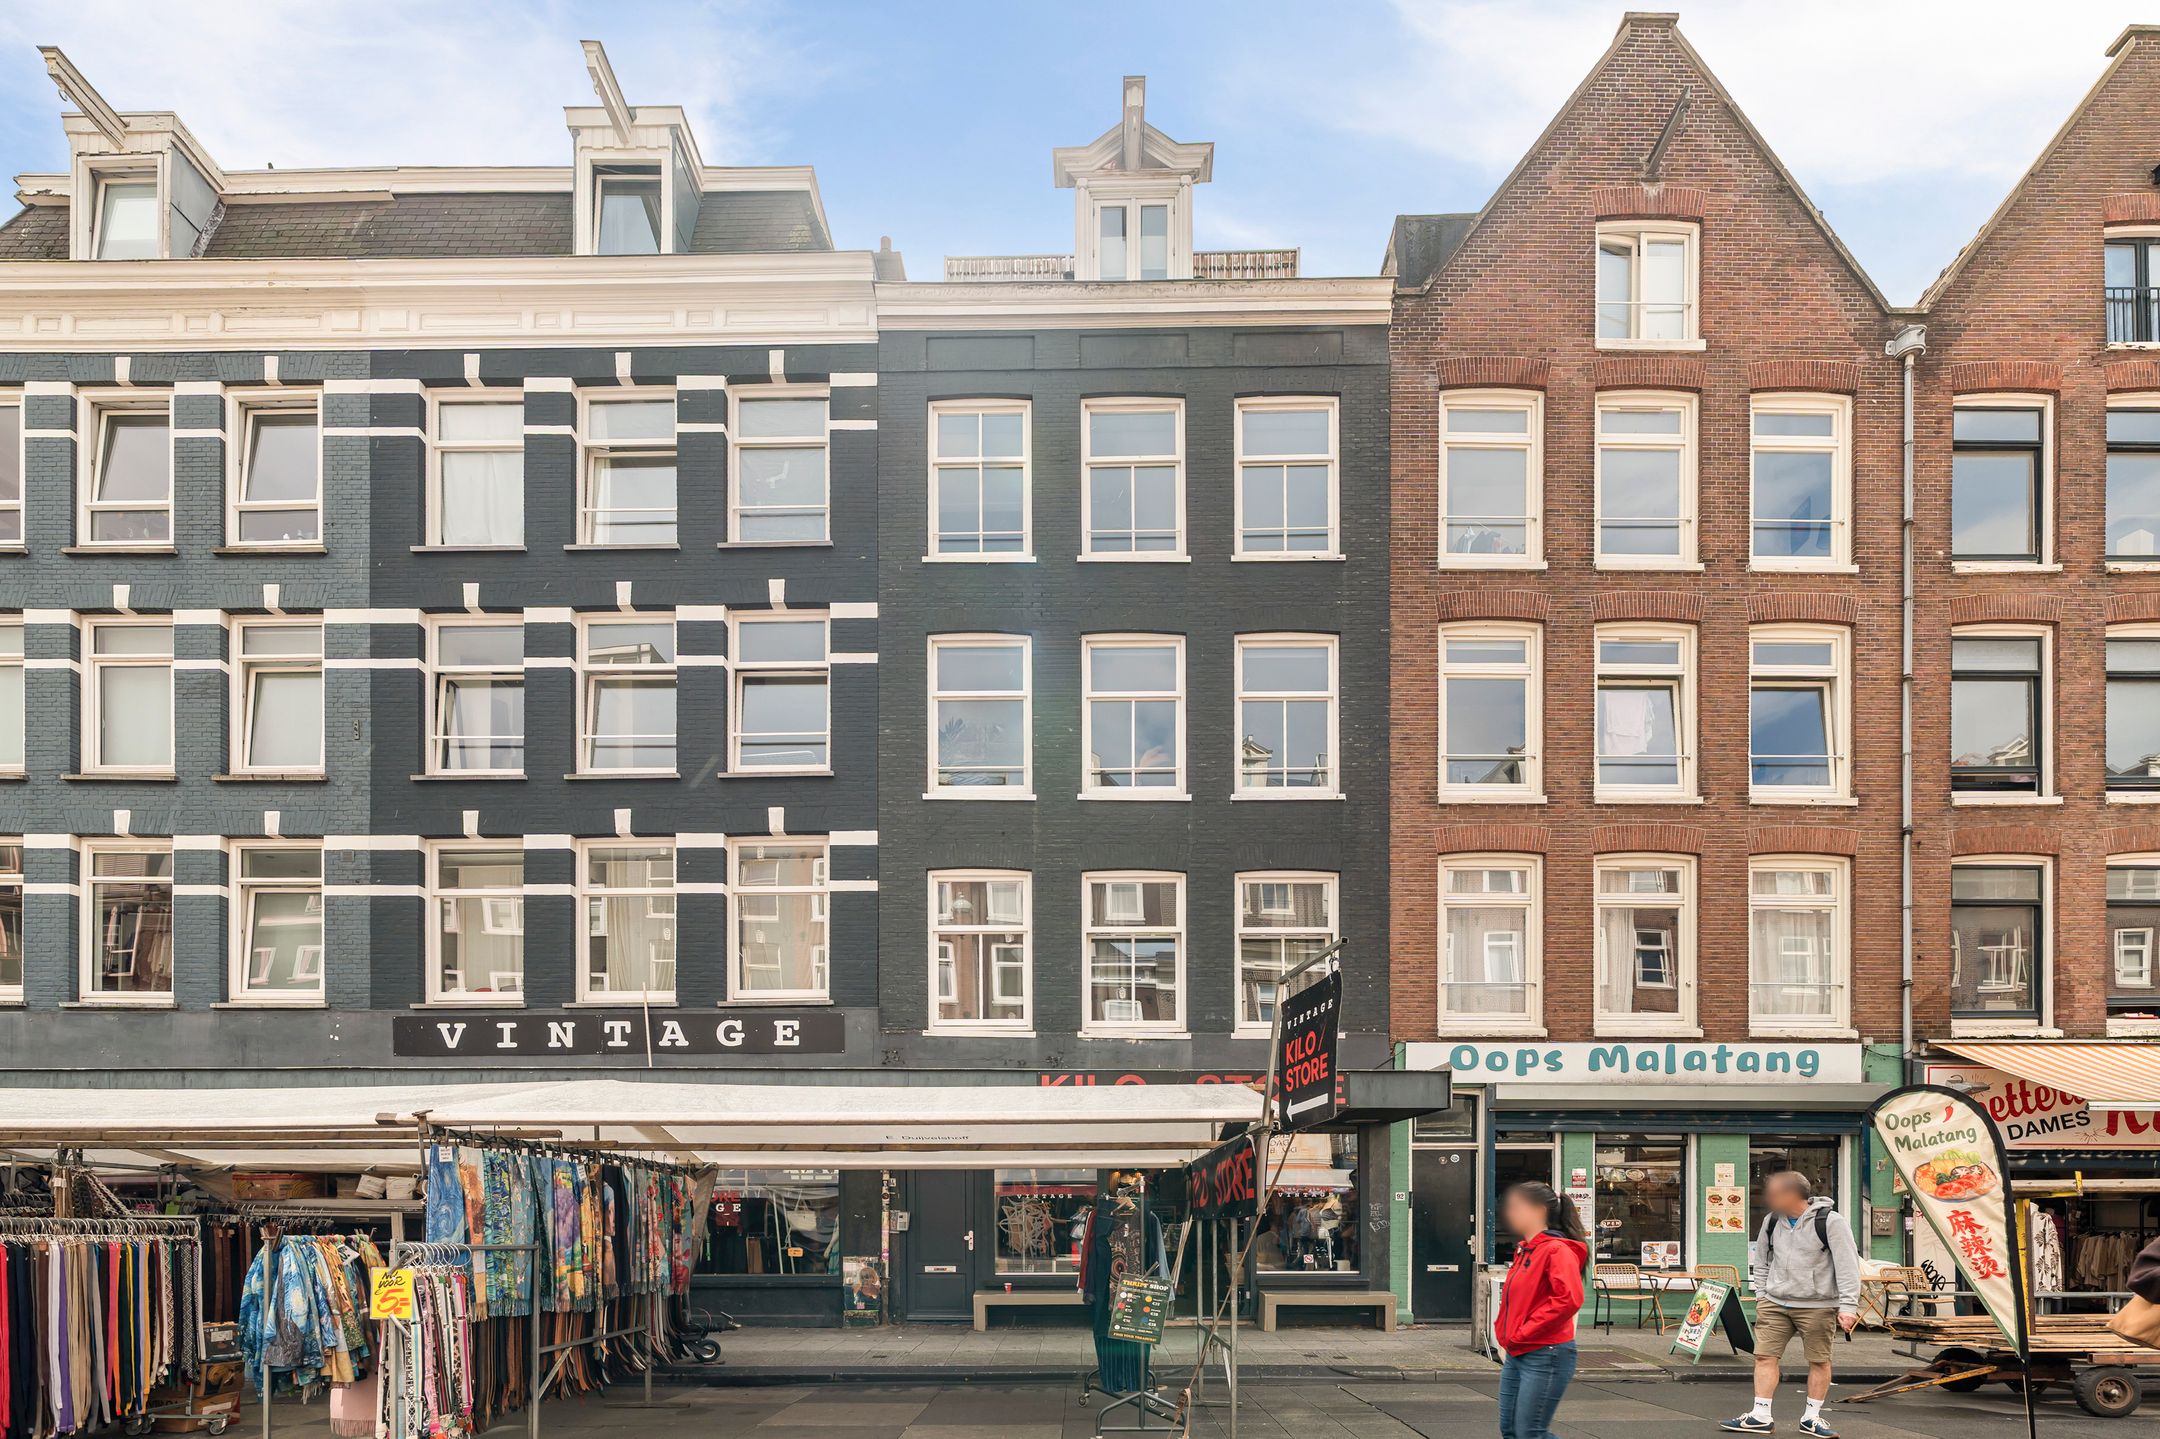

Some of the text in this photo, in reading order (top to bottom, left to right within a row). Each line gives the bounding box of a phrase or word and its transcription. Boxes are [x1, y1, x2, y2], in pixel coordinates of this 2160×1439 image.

[1287, 999, 1334, 1029] VINTAGE
[437, 1020, 800, 1048] VINTAGE
[1286, 1053, 1329, 1092] STORE
[1449, 1043, 1820, 1077] Oops Malatang
[1885, 1111, 1931, 1132] Oops
[2007, 1111, 2090, 1140] DAMES
[1894, 1127, 1977, 1152] Malatang
[1946, 1209, 2006, 1280] 麻辣烫
[1122, 1280, 1149, 1288] THRIFT
